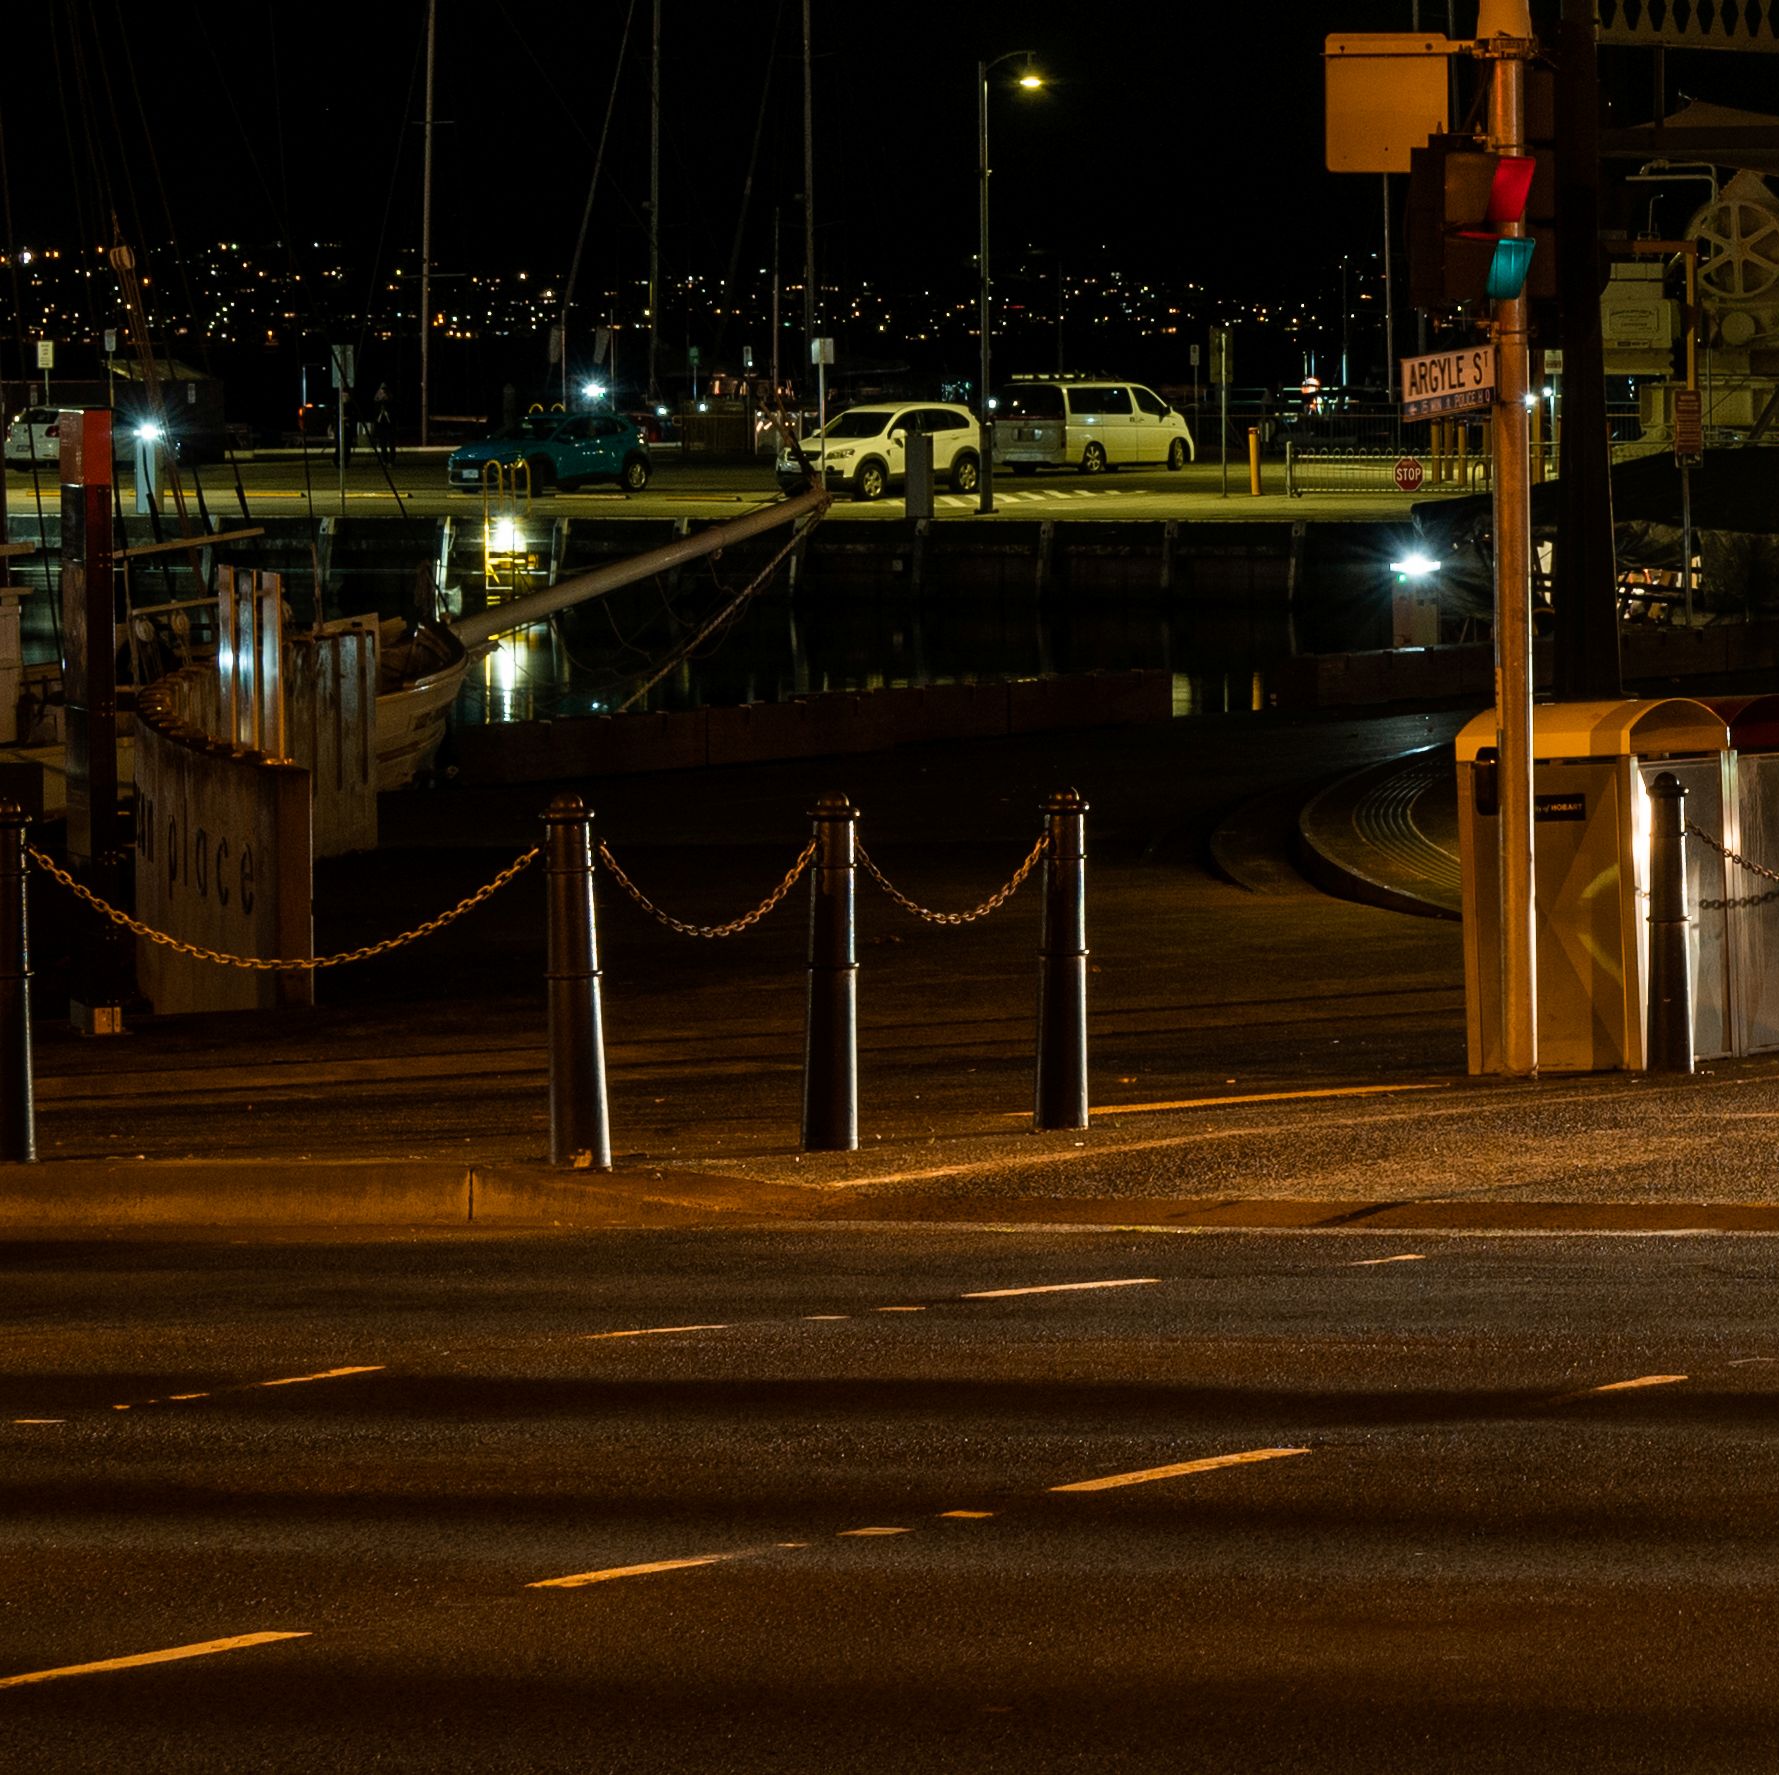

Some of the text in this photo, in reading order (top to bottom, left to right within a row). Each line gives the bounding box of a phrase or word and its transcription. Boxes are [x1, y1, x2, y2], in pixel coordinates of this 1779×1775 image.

[1408, 355, 1466, 396] ARGYLE
[1396, 467, 1422, 481] STOP
[167, 797, 255, 915] place
